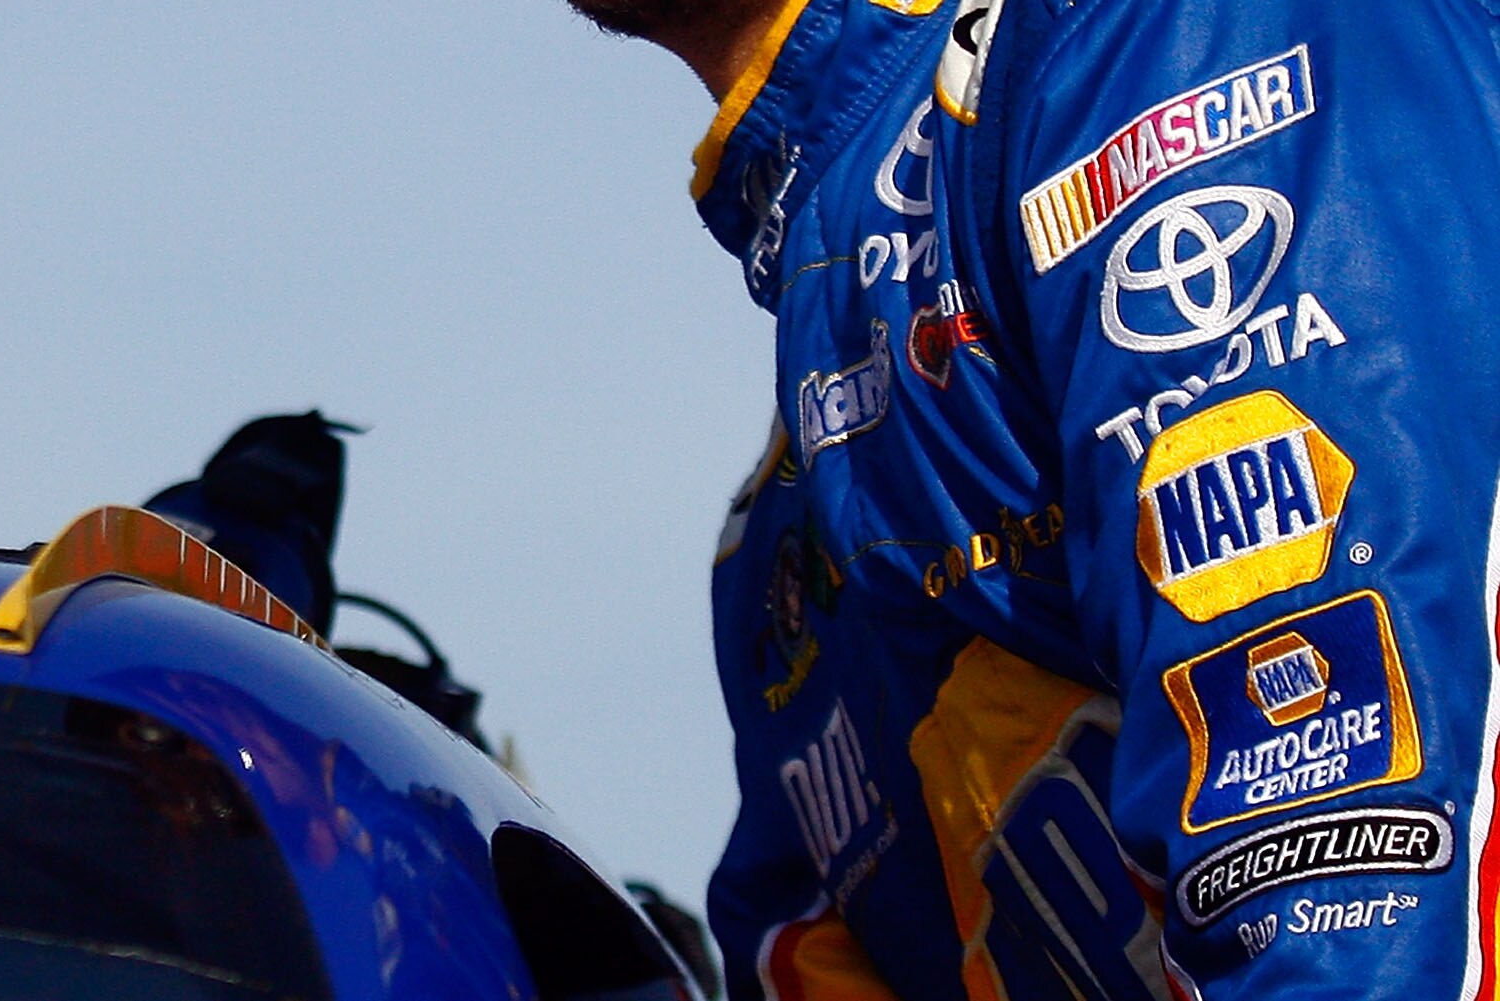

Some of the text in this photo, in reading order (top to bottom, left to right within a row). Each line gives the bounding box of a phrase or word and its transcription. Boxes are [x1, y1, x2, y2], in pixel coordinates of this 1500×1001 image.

[1108, 63, 1295, 193] NASCAR
[1155, 437, 1316, 575] NAPA
[1257, 655, 1318, 707] NAPA
[1244, 753, 1349, 805] CENTER
[1196, 824, 1431, 910] FREIGHTLINER
[1287, 891, 1398, 935] Smart
